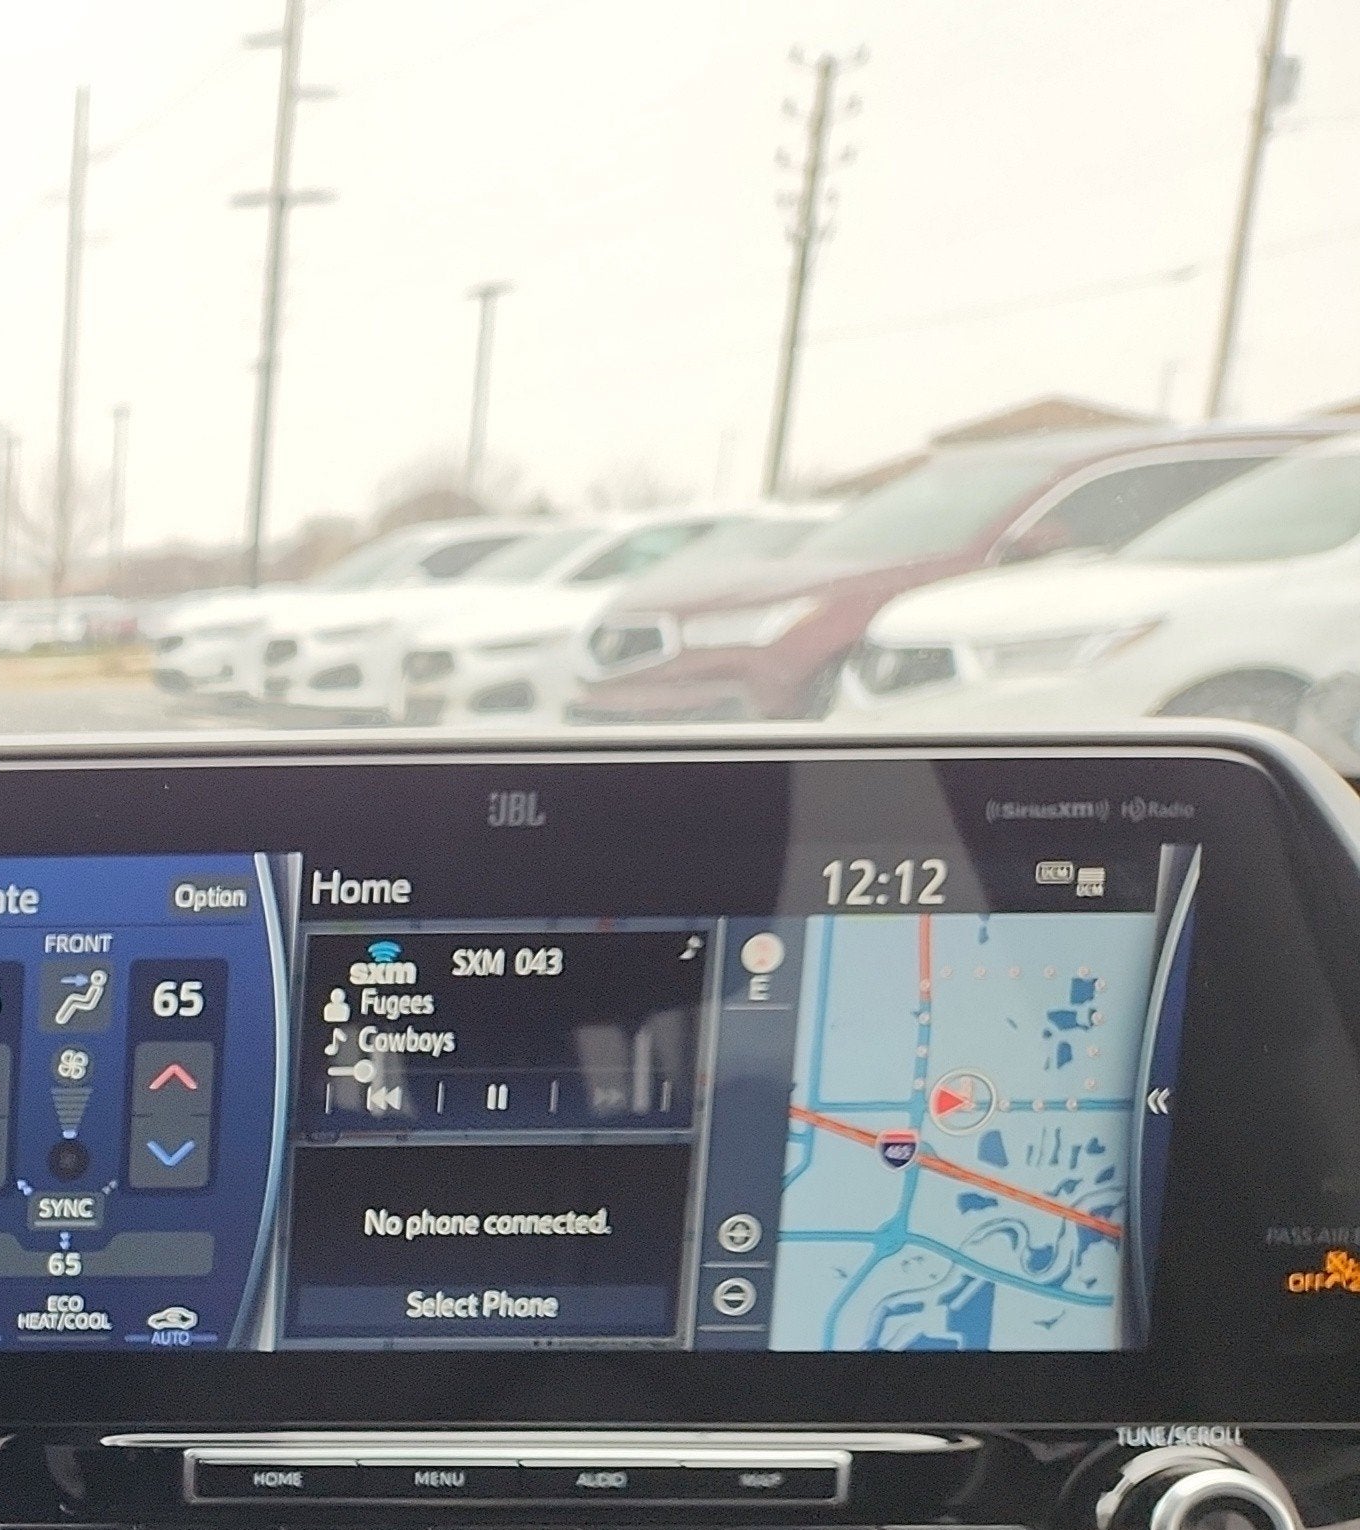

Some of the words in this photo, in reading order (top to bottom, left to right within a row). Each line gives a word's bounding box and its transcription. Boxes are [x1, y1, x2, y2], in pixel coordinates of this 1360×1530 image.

[488, 791, 546, 827] JBL
[311, 870, 412, 904] Home
[822, 858, 949, 906] 12:12
[174, 883, 248, 912] Option
[44, 933, 113, 953] FRONT
[349, 962, 417, 985] sxm
[452, 948, 506, 976] SXM
[514, 947, 564, 976] 043
[152, 980, 204, 1017] 65
[748, 974, 770, 1001] E
[360, 988, 434, 1020] Fugees
[358, 1025, 456, 1057] Cowboys
[38, 1198, 94, 1218] SYNC
[364, 1208, 402, 1236] No
[405, 1208, 479, 1240] phone
[483, 1207, 612, 1236] connected.
[48, 1252, 82, 1276] 65
[47, 1295, 84, 1312] ECO
[406, 1291, 479, 1318] Select
[482, 1290, 559, 1318] Phone
[18, 1312, 112, 1331] HEAT/COOL
[151, 1331, 190, 1346] AUTO
[1116, 1425, 1243, 1447] TUNE/SCROLL
[254, 1471, 303, 1487] HOME
[414, 1471, 465, 1487] MENU
[576, 1471, 628, 1488] AUDIO
